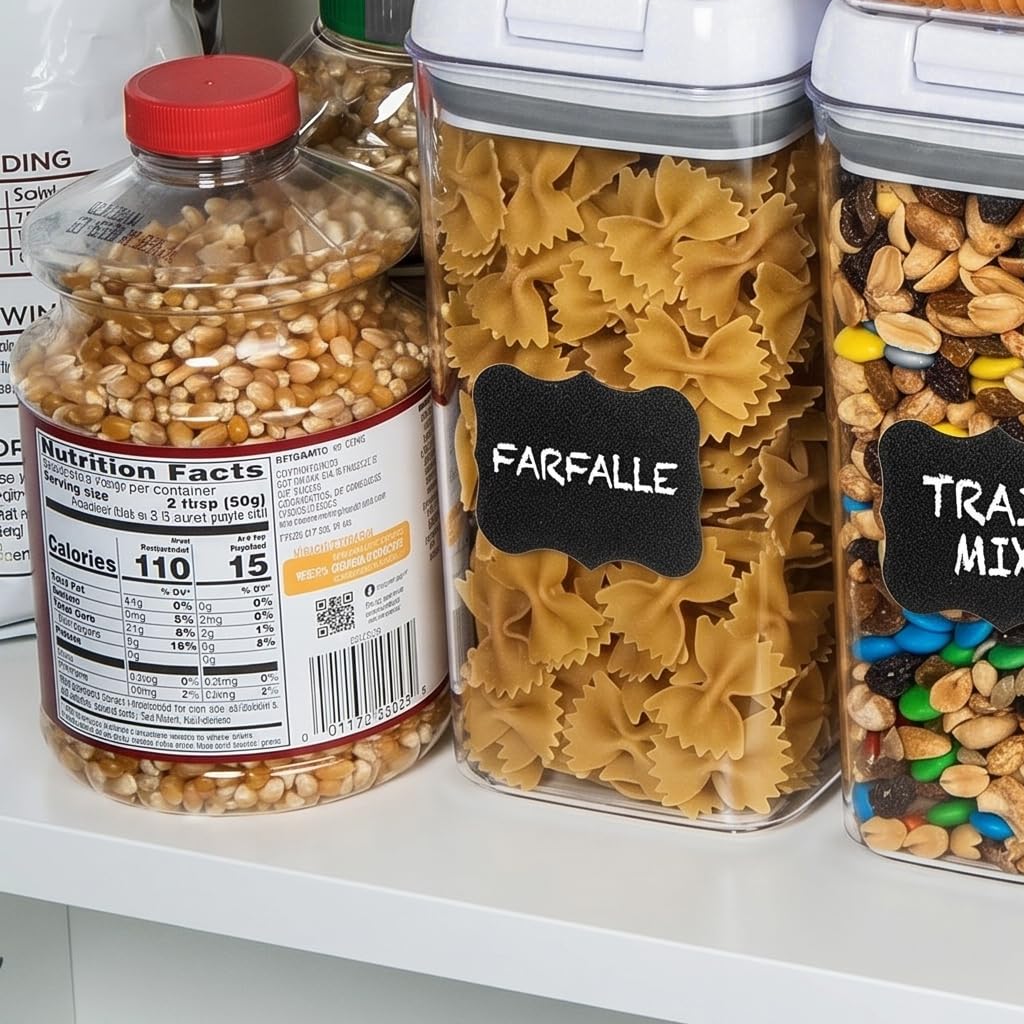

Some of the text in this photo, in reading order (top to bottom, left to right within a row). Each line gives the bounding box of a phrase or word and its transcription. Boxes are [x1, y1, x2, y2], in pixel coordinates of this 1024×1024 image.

[41, 436, 264, 482] Nutrition Facts
[493, 442, 677, 496] FARFALLE
[43, 469, 81, 496] Serving
[84, 487, 109, 502] size
[167, 498, 176, 509] 2
[224, 493, 265, 509] (50g)
[129, 483, 216, 497] per container
[48, 534, 117, 573] Calories
[135, 553, 191, 580] 110
[228, 552, 268, 578] 15
[173, 601, 193, 611] 0%
[198, 601, 213, 612] 0g
[253, 598, 273, 608] 0%
[125, 609, 146, 623] 0mg
[199, 615, 223, 627] 2mg
[254, 611, 274, 621] 0%
[126, 623, 275, 640] 21g 8% 2g 1%
[202, 642, 215, 653] 0g
[256, 638, 276, 648] 8%
[128, 650, 216, 666] 0g 0g
